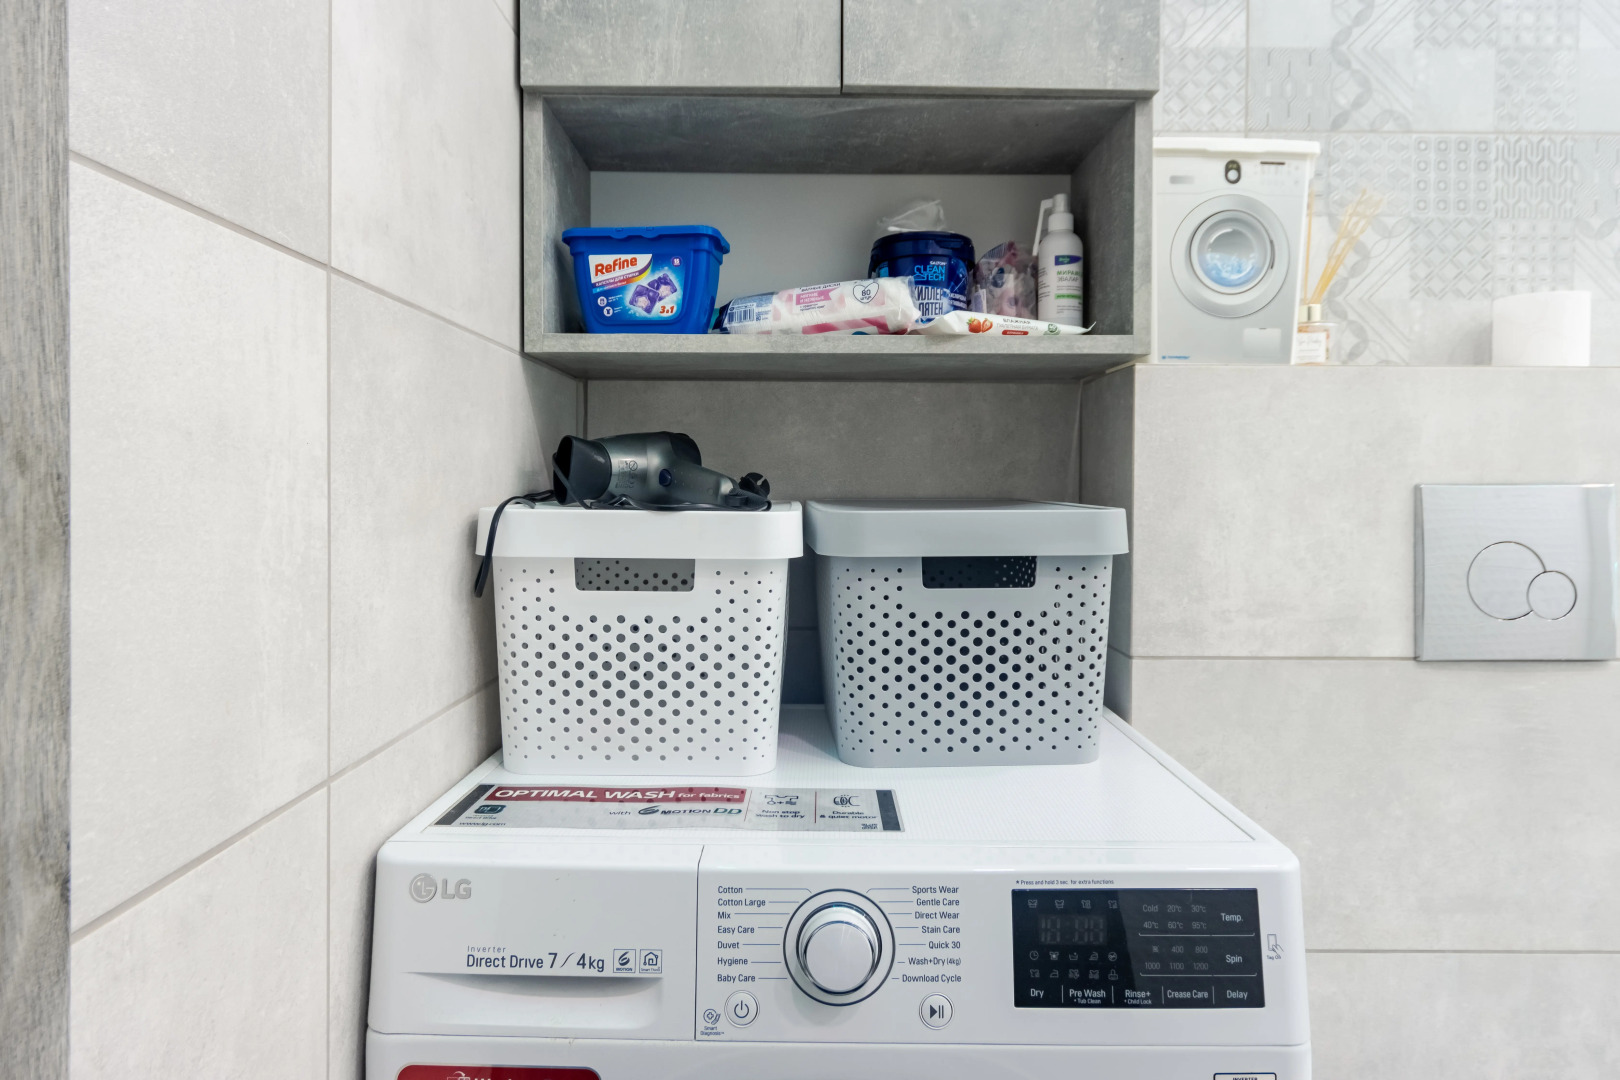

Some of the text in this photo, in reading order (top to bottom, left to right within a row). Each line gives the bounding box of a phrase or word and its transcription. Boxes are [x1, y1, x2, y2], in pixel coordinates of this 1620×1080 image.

[595, 257, 638, 277] Refine
[914, 264, 946, 274] CLEAN
[922, 272, 946, 281] TECH
[861, 289, 871, 297] 80
[495, 789, 598, 798] OPTIMAL
[605, 789, 675, 799] WASH
[441, 879, 472, 900] LG
[717, 885, 743, 894] Cotton
[912, 885, 959, 894] Sports Wear
[717, 898, 766, 907] Cotton Large
[916, 898, 960, 906] Gentle Care
[717, 911, 731, 919] Mix
[914, 911, 960, 919] Direct Wear
[1221, 913, 1243, 923] Temp.
[717, 926, 755, 934] Easy Care
[921, 925, 960, 933] Stain Care
[467, 945, 506, 953] Inverter
[717, 941, 740, 949] Duvet
[928, 941, 961, 950] Quick 30
[1171, 946, 1208, 954] 400 800
[467, 954, 506, 968] Direct
[509, 954, 544, 969] Drive
[717, 957, 748, 967] Hygiene
[908, 957, 961, 966] Wash+Dry (4kg)
[1225, 955, 1243, 964] Spin
[1145, 962, 1209, 970] 1000 1100 1200
[717, 974, 756, 983] Baby Care
[902, 974, 962, 983] Download Cycle
[1030, 988, 1044, 999] Dry
[1069, 989, 1106, 998] Pre Wash
[1125, 989, 1151, 998] Rinse+
[1167, 990, 1208, 998] Crease Care
[1227, 990, 1248, 1000] Delay
